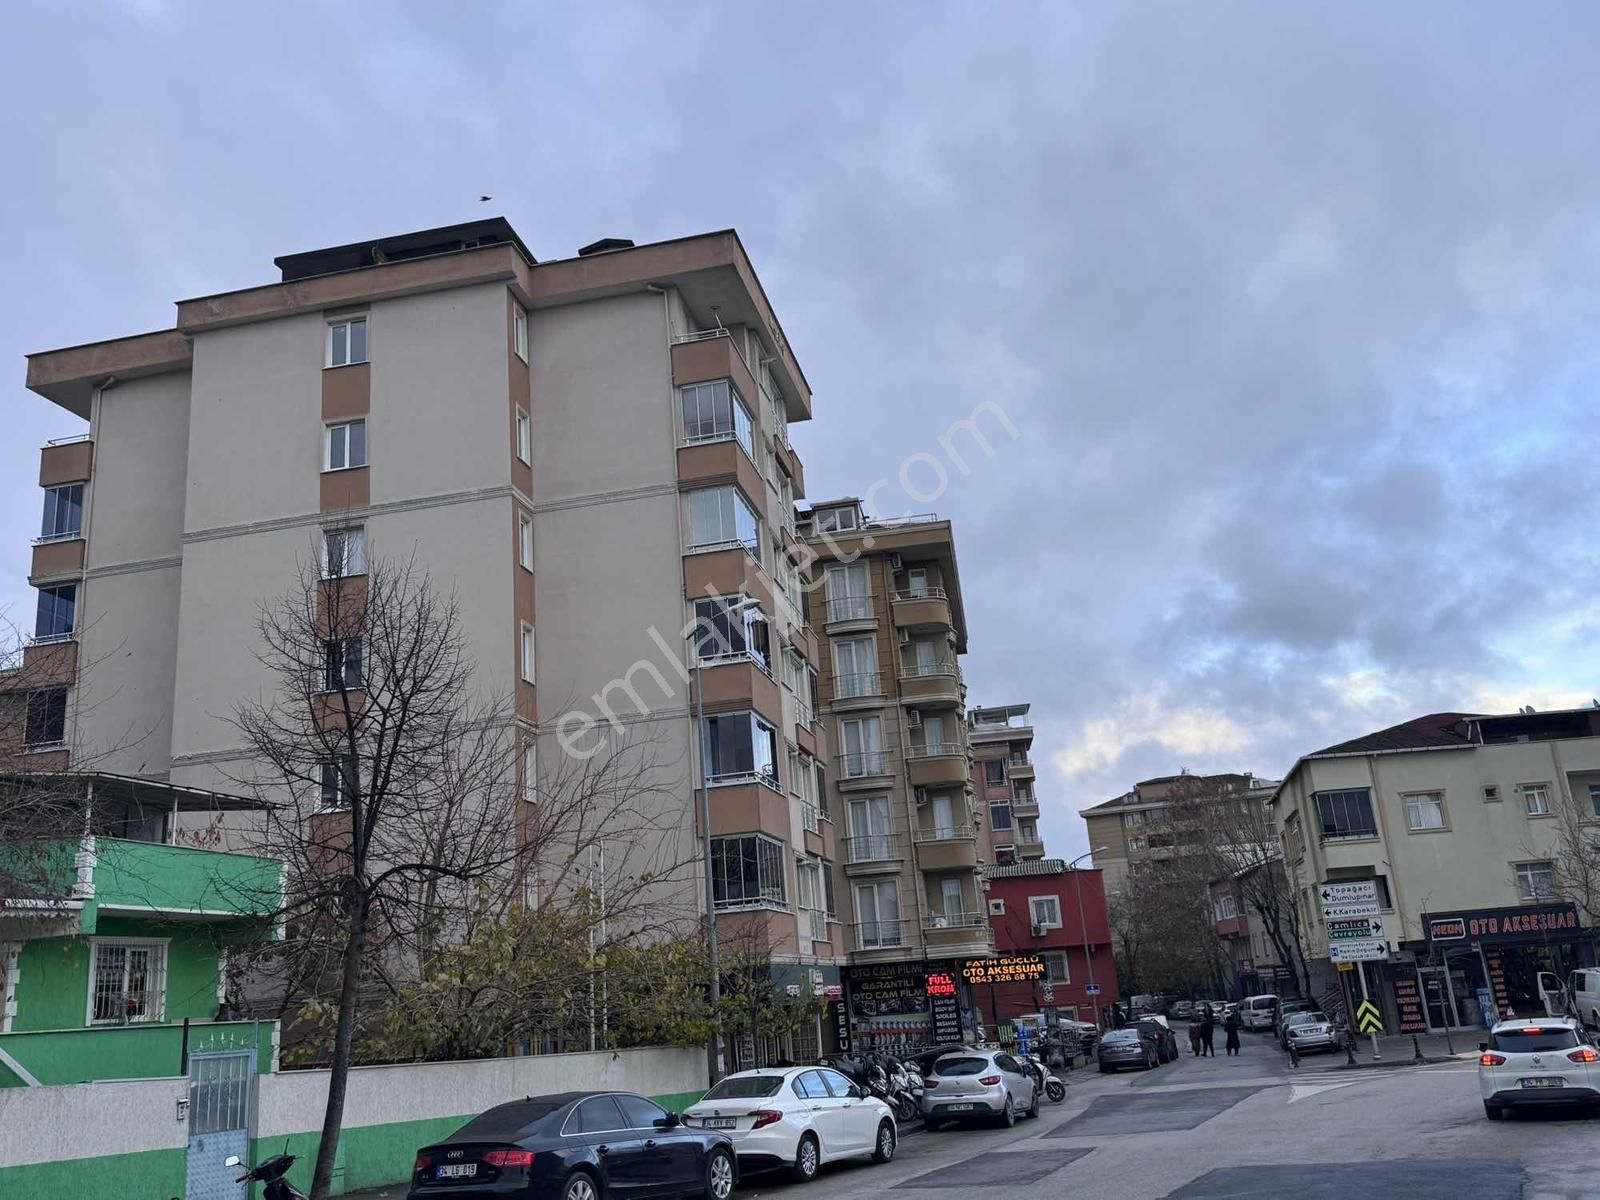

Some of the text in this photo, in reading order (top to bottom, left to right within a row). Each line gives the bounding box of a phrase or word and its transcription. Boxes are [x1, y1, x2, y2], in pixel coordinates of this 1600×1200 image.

[1469, 917, 1498, 935] OTO
[1502, 911, 1576, 933] AKSESUAR
[966, 959, 997, 967] FATİH
[850, 967, 871, 978] OTO
[872, 966, 896, 977] CAM
[963, 967, 985, 977] OTO
[987, 963, 1045, 975] AKSESUAR
[928, 976, 952, 985] FULL
[852, 992, 873, 1001] OTO
[875, 990, 898, 999] CAM
